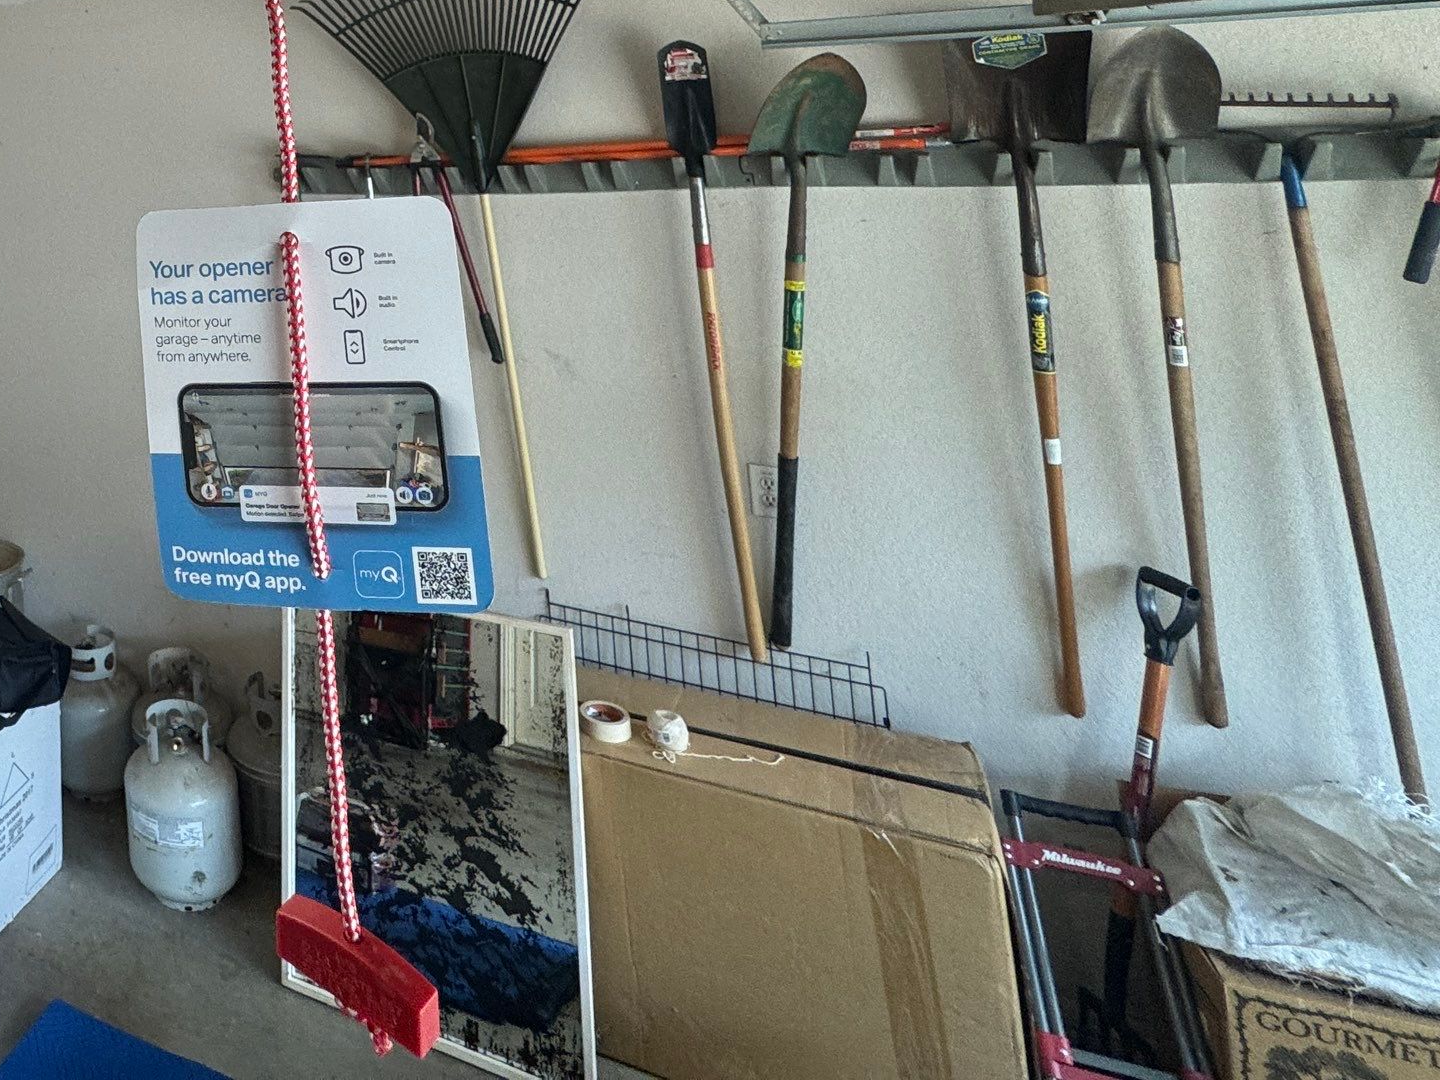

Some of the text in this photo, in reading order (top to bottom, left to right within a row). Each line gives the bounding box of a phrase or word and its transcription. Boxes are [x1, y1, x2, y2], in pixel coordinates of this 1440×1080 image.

[992, 34, 1024, 43] Kodiak
[150, 261, 274, 280] Your opener
[151, 287, 287, 305] has a camera
[154, 317, 231, 330] Monitor your
[1032, 312, 1047, 354] Kodiak
[155, 335, 198, 347] garage
[211, 333, 261, 346] anytime
[157, 350, 251, 364] from anywhere.
[172, 545, 299, 567] Download the
[174, 567, 307, 593] free myQ app.
[360, 565, 399, 584] myQ
[1042, 849, 1122, 875] Milwaukee
[1255, 1010, 1440, 1069] GOURMET
